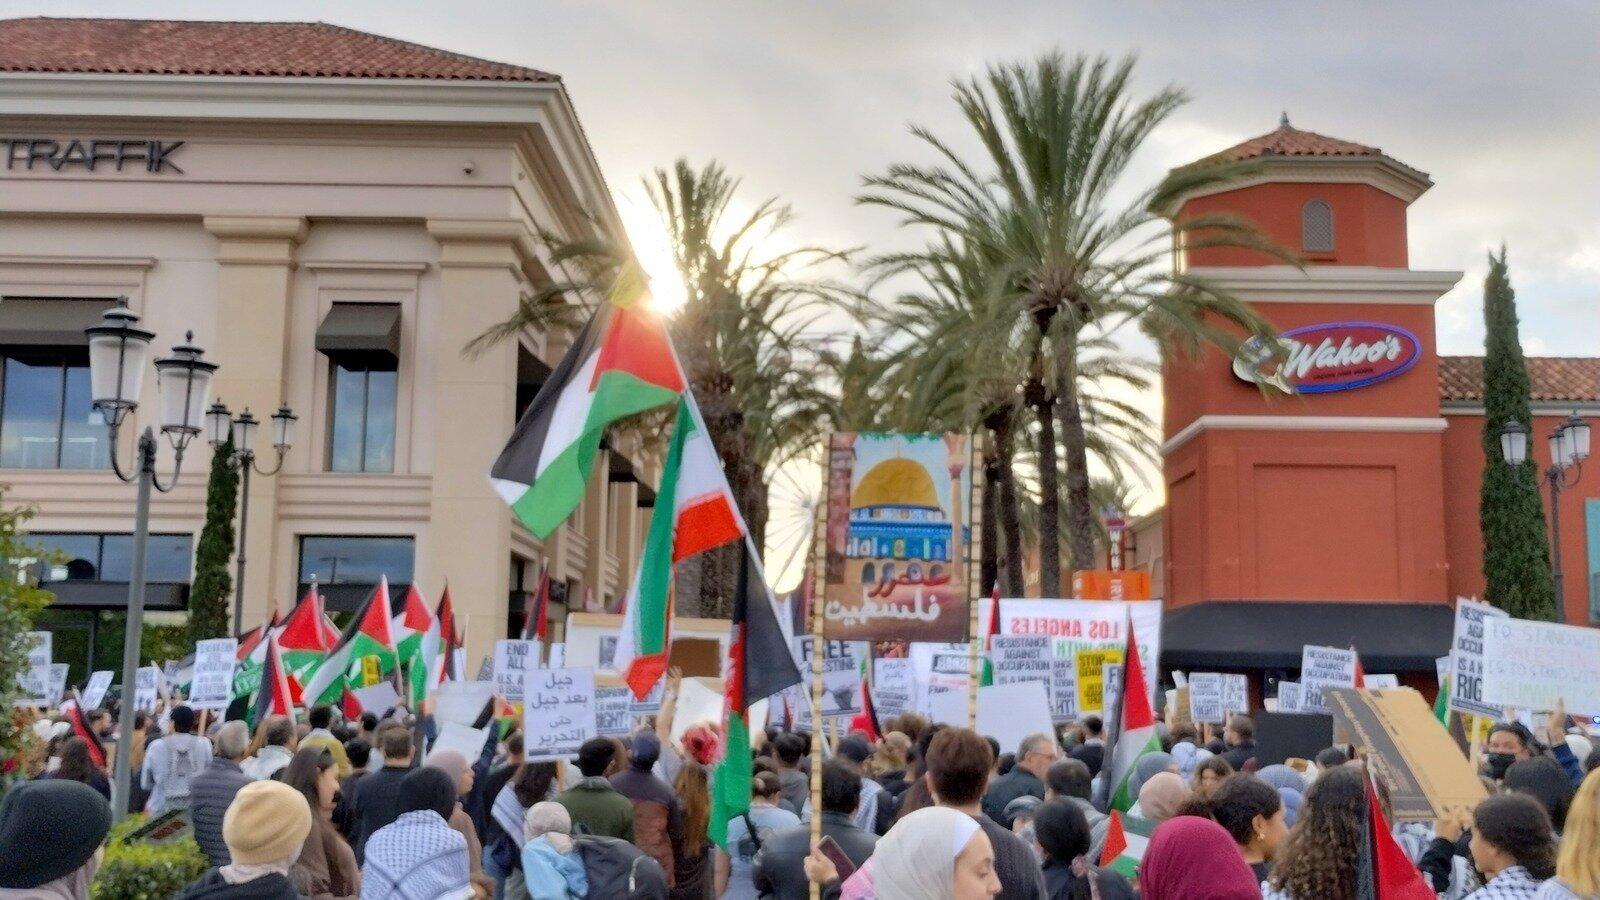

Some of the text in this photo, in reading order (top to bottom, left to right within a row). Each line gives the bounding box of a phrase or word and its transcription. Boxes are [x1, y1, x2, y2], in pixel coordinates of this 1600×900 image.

[0, 139, 186, 174] TRAFFIK
[1277, 335, 1401, 378] Wahoo's
[824, 585, 942, 626] فلسطين
[507, 643, 529, 655] END
[801, 638, 852, 662] FEE
[995, 637, 1048, 648] RESISTANCE
[1004, 649, 1041, 659] AGAINST
[508, 657, 527, 669] ALL
[996, 661, 1050, 671] OCCUPATION
[545, 673, 573, 690] جيل
[531, 692, 560, 710] جيل
[563, 693, 588, 708] بعد
[538, 728, 586, 747] التحرير
